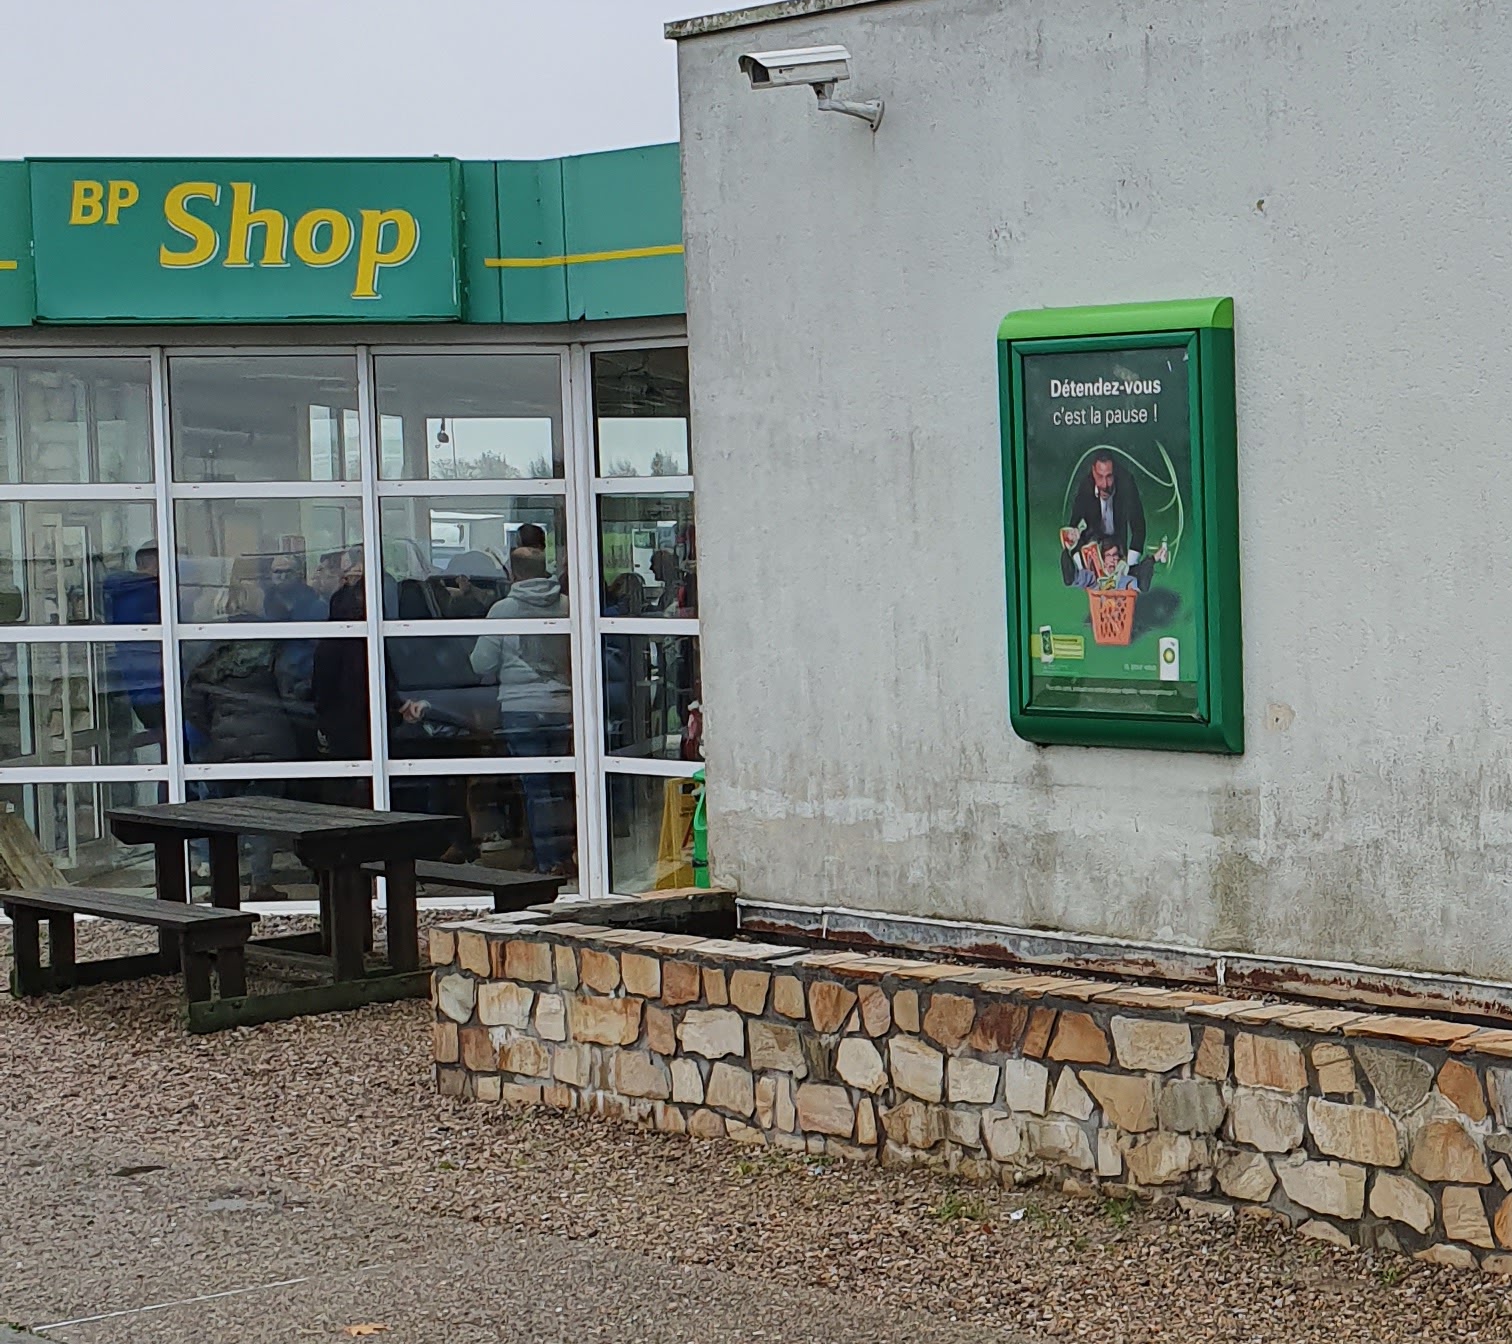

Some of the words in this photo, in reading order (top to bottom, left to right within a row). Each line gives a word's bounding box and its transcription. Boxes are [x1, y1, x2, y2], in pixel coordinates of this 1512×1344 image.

[69, 180, 139, 226] BP
[160, 182, 420, 299] Shop
[1050, 377, 1161, 398] Détendez-vous
[1053, 407, 1086, 425] c'est
[1090, 406, 1101, 424] la
[1105, 408, 1148, 428] pause
